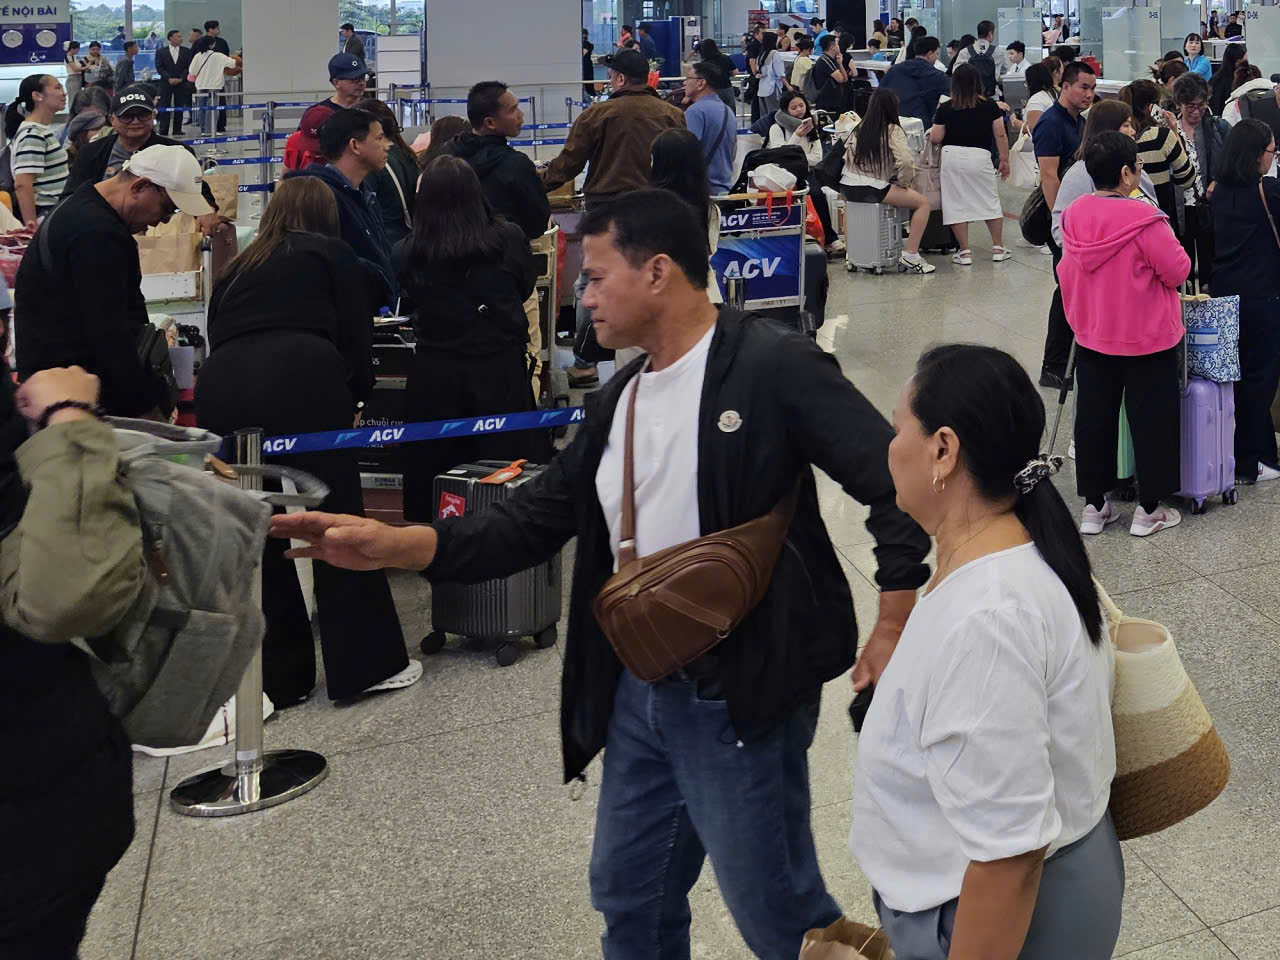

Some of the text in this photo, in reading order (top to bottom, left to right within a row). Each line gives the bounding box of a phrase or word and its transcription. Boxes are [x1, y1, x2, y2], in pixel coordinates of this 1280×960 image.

[0, 5, 57, 18] Ế NỘI BÀI
[1247, 11, 1259, 20] D-06
[120, 93, 146, 104] BOSS
[723, 256, 782, 280] ACV
[367, 416, 389, 427] chuỗi
[263, 417, 507, 453] ACV ACV ACV
